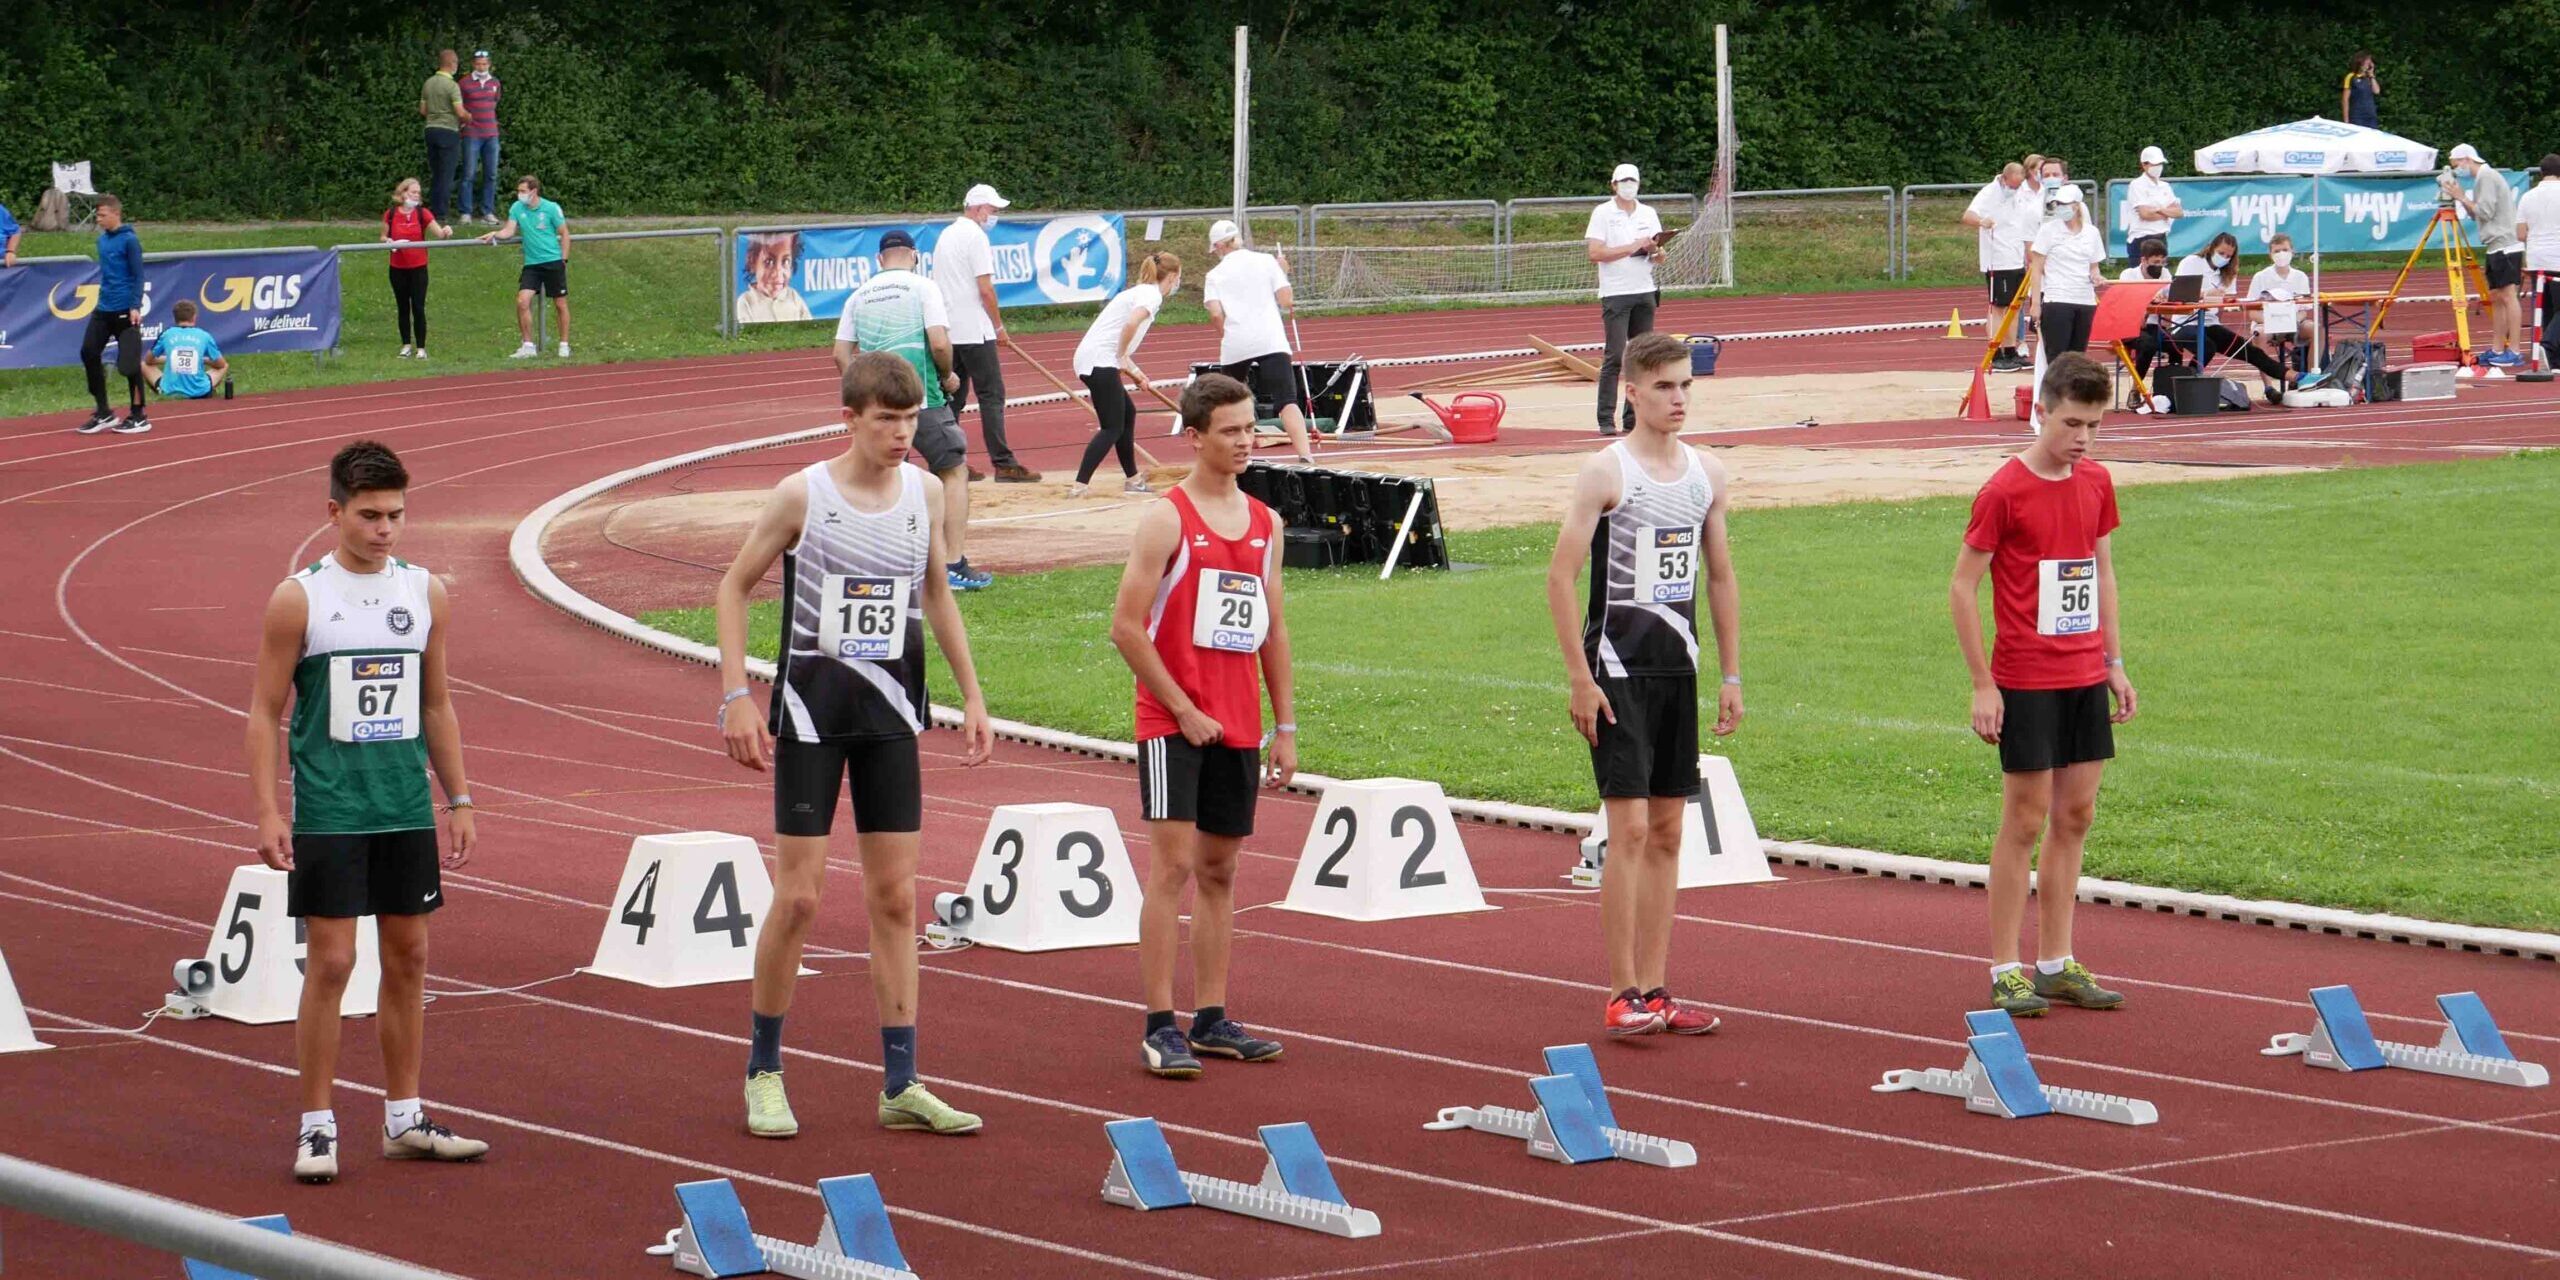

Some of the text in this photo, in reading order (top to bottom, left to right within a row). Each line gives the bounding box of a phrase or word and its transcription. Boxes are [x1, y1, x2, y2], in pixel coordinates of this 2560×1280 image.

[804, 256, 870, 291] KINDER
[253, 274, 301, 310] GLS
[254, 313, 311, 331] We deliver!
[178, 358, 191, 367] 38
[1677, 531, 1692, 544] GLS
[1659, 550, 1689, 580] 53
[2080, 565, 2093, 577] GLS
[871, 584, 891, 596] GLS
[1241, 580, 1256, 593] GLS
[1670, 584, 1690, 594] PLAN
[2061, 584, 2090, 612] 56
[838, 603, 895, 635] 163
[1219, 597, 1253, 629] 29
[2072, 617, 2090, 626] PLAN
[861, 642, 888, 651] PLAN
[1231, 634, 1253, 645] PLAN
[379, 662, 401, 675] GLS
[358, 684, 398, 716] 67
[373, 722, 402, 733] PLAN
[1314, 805, 1358, 889] 2
[1390, 804, 1447, 890] 2
[983, 828, 1025, 916] 3
[1056, 830, 1113, 918] 3
[621, 859, 660, 946] 4
[692, 861, 754, 948] 4
[220, 892, 262, 984] 5
